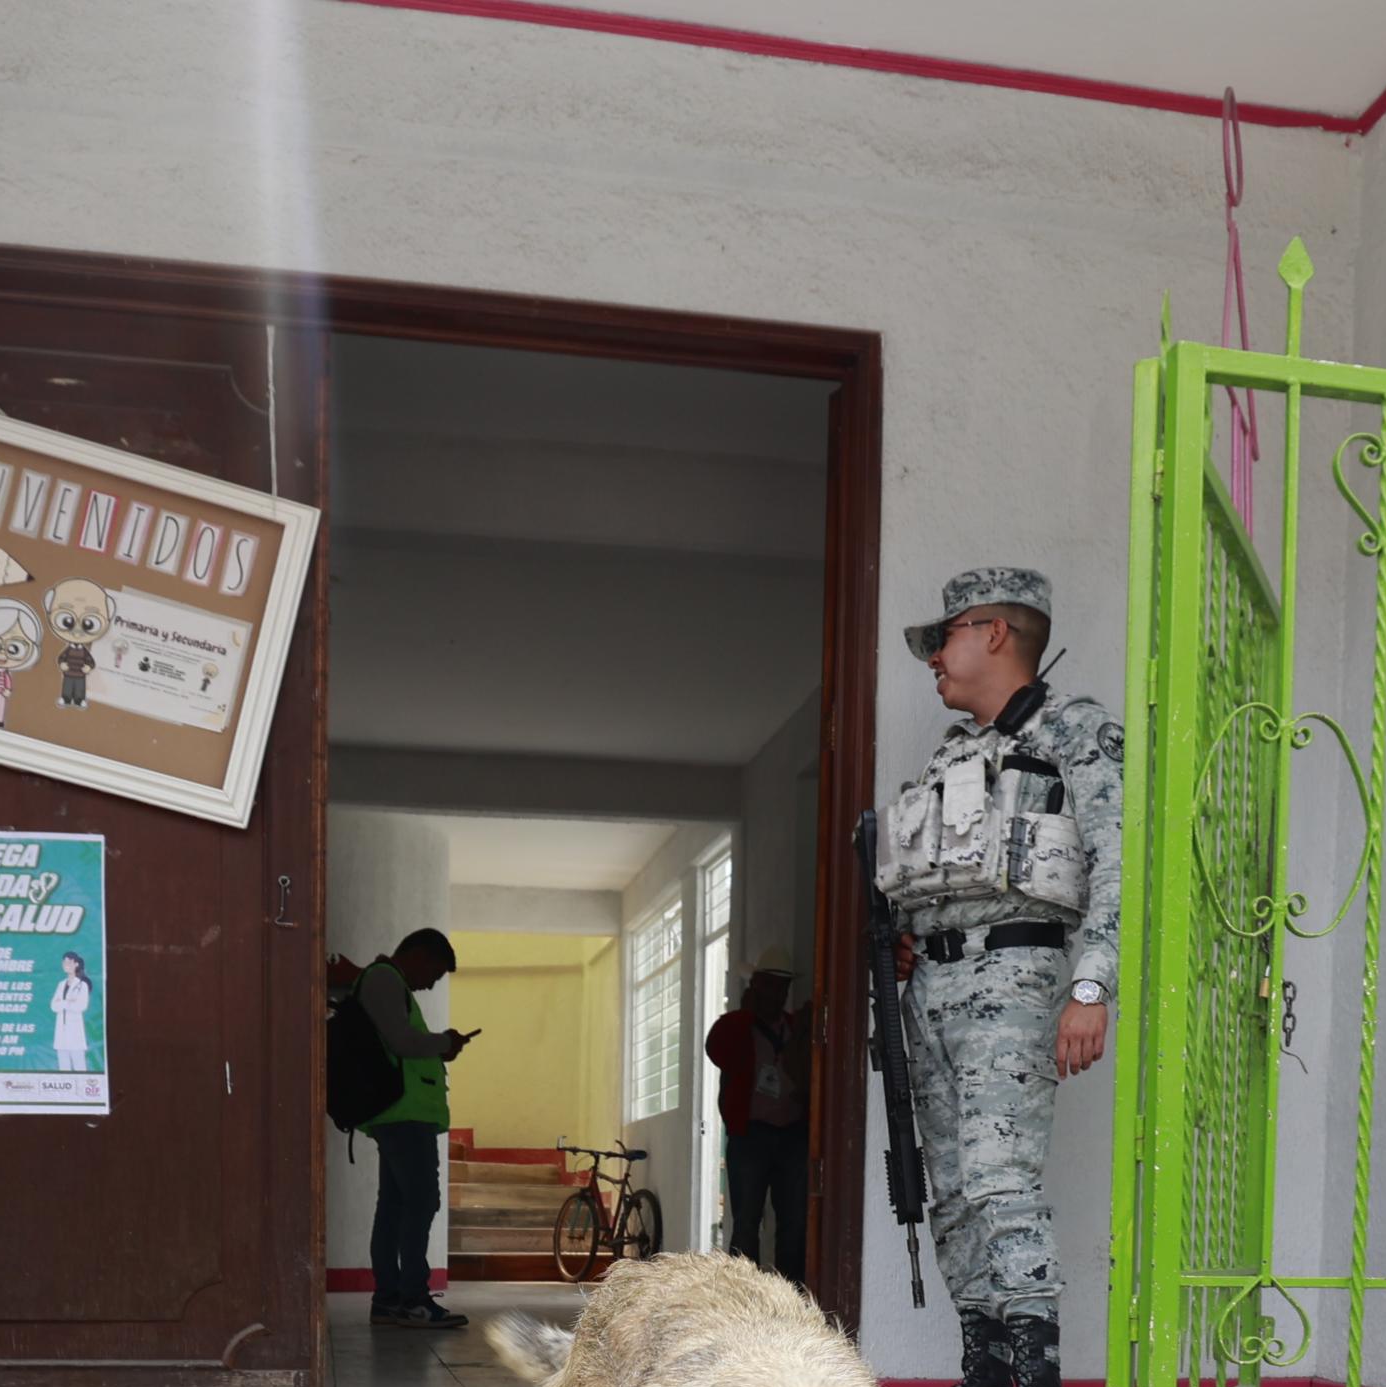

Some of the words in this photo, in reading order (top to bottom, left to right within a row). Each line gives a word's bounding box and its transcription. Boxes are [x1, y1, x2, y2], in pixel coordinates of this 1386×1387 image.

[114, 615, 160, 637] Primaria
[161, 630, 169, 642] y
[171, 631, 228, 657] Secundaria
[41, 1081, 72, 1090] SALUD
